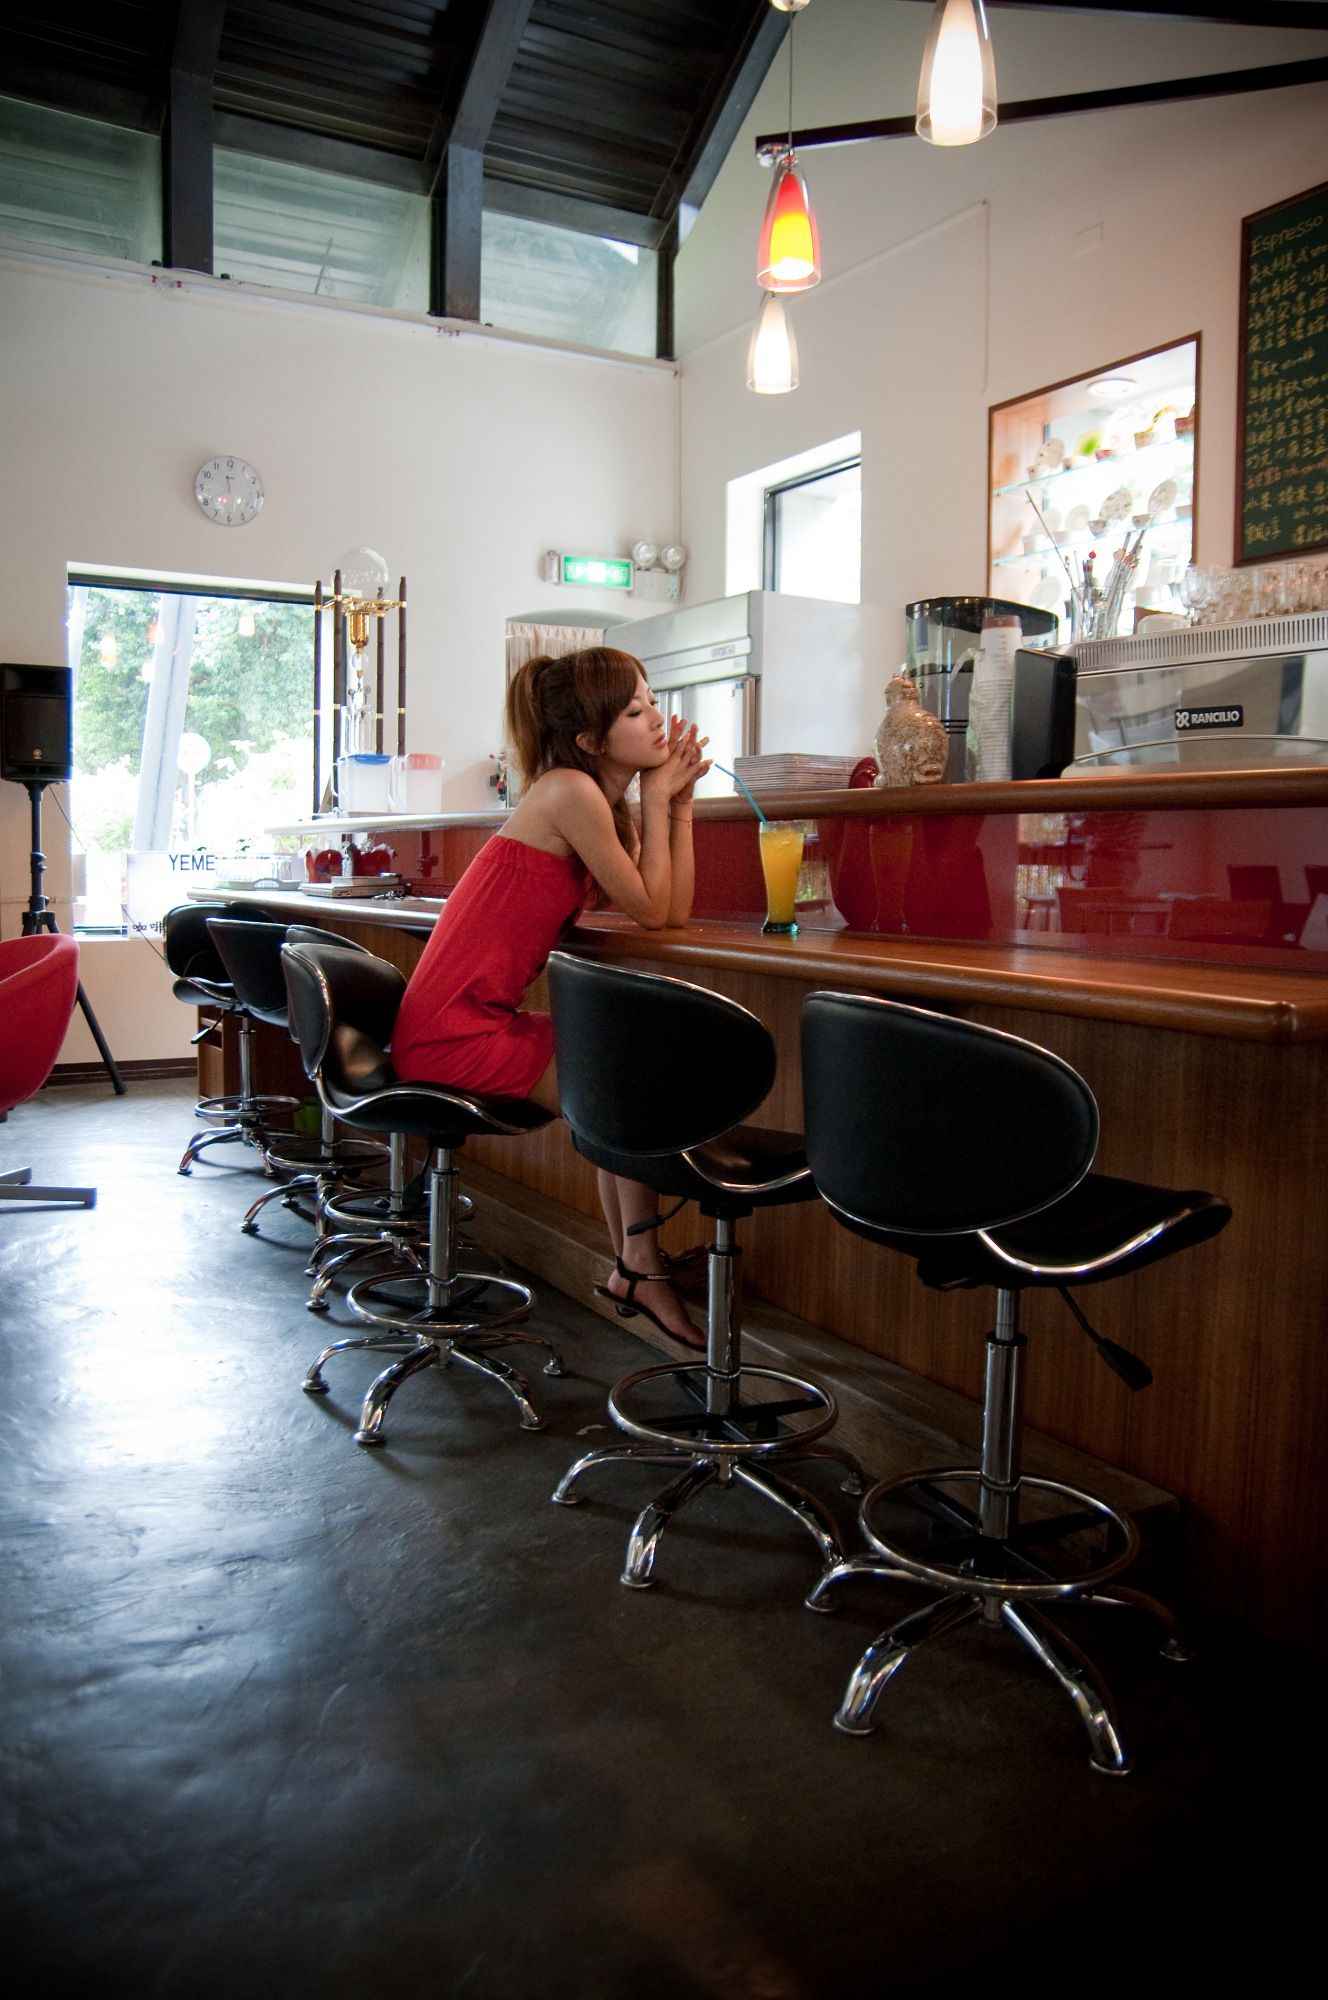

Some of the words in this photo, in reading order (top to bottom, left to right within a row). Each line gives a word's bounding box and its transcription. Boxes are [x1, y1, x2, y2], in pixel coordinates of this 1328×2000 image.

[1249, 215, 1324, 256] Espresso
[1190, 710, 1240, 724] RANCILIO
[168, 854, 216, 871] YEME
